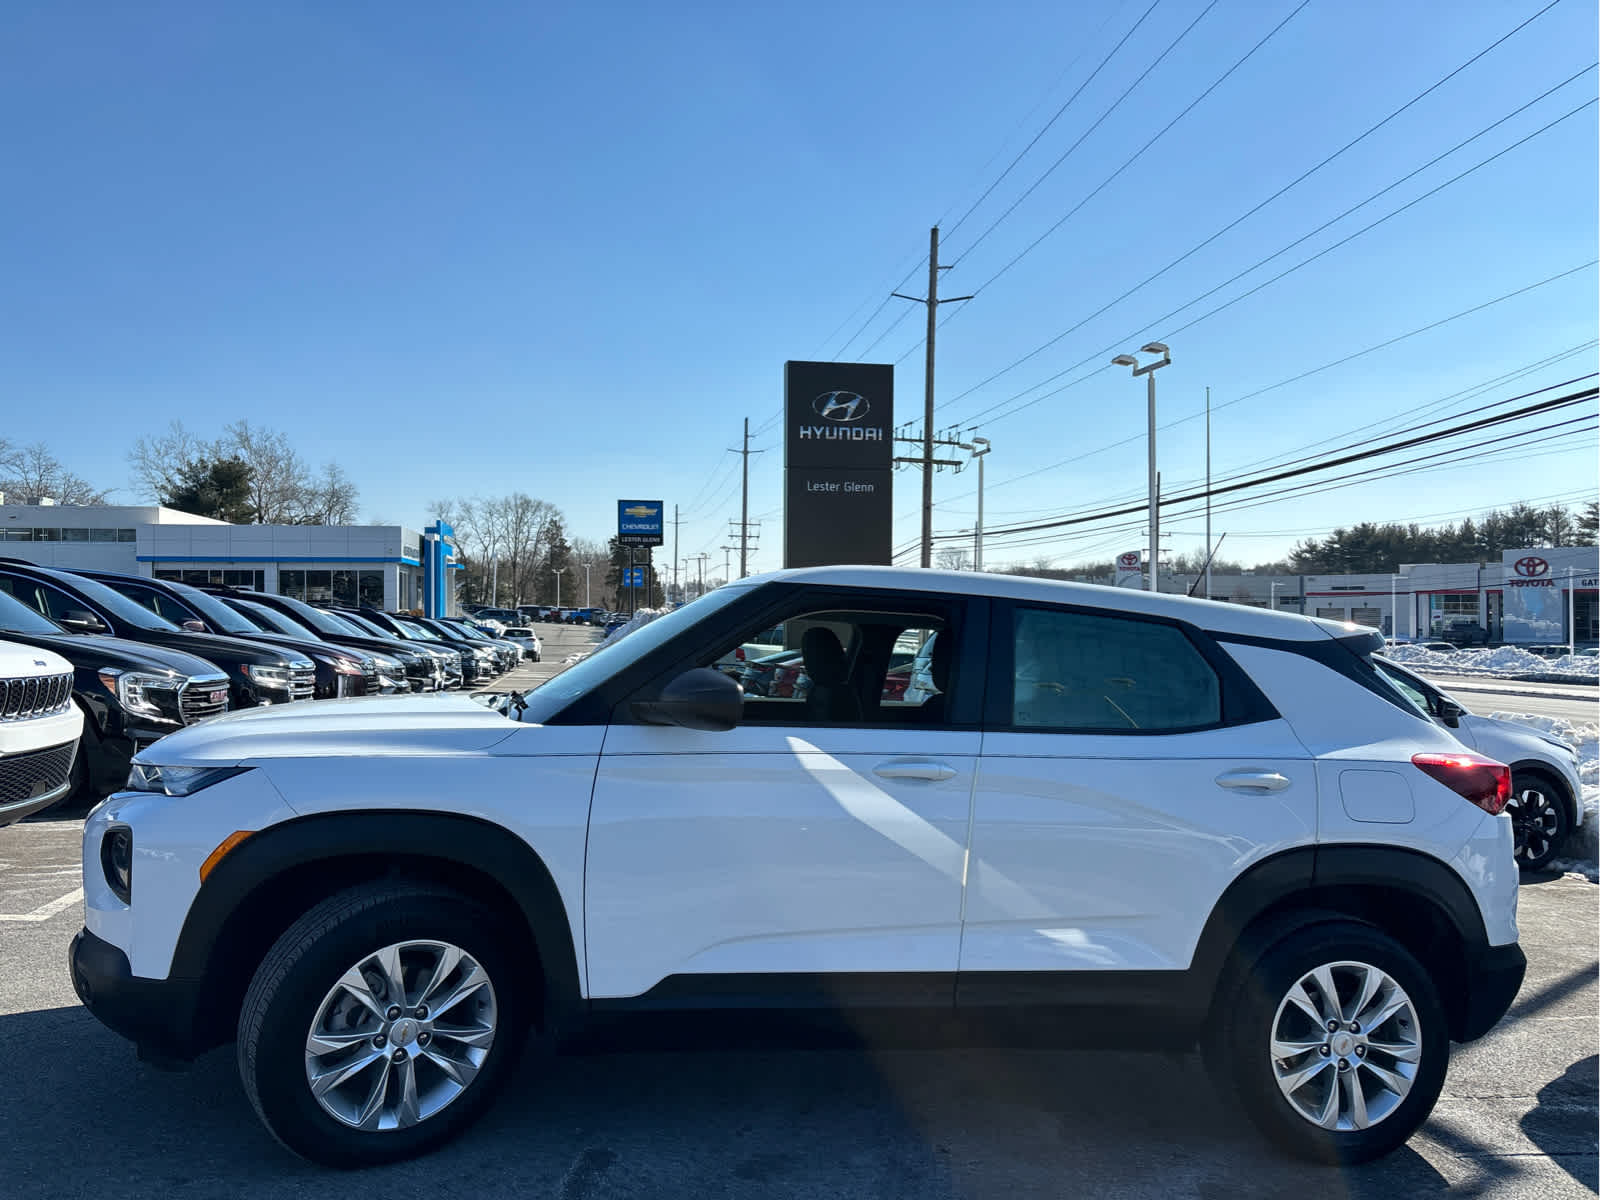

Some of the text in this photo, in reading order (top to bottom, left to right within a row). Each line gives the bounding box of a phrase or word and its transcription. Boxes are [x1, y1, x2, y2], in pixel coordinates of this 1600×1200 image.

[799, 425, 882, 440] HYUNDAI
[807, 481, 874, 492] Lester Glenn
[1509, 579, 1554, 587] TOYOTA
